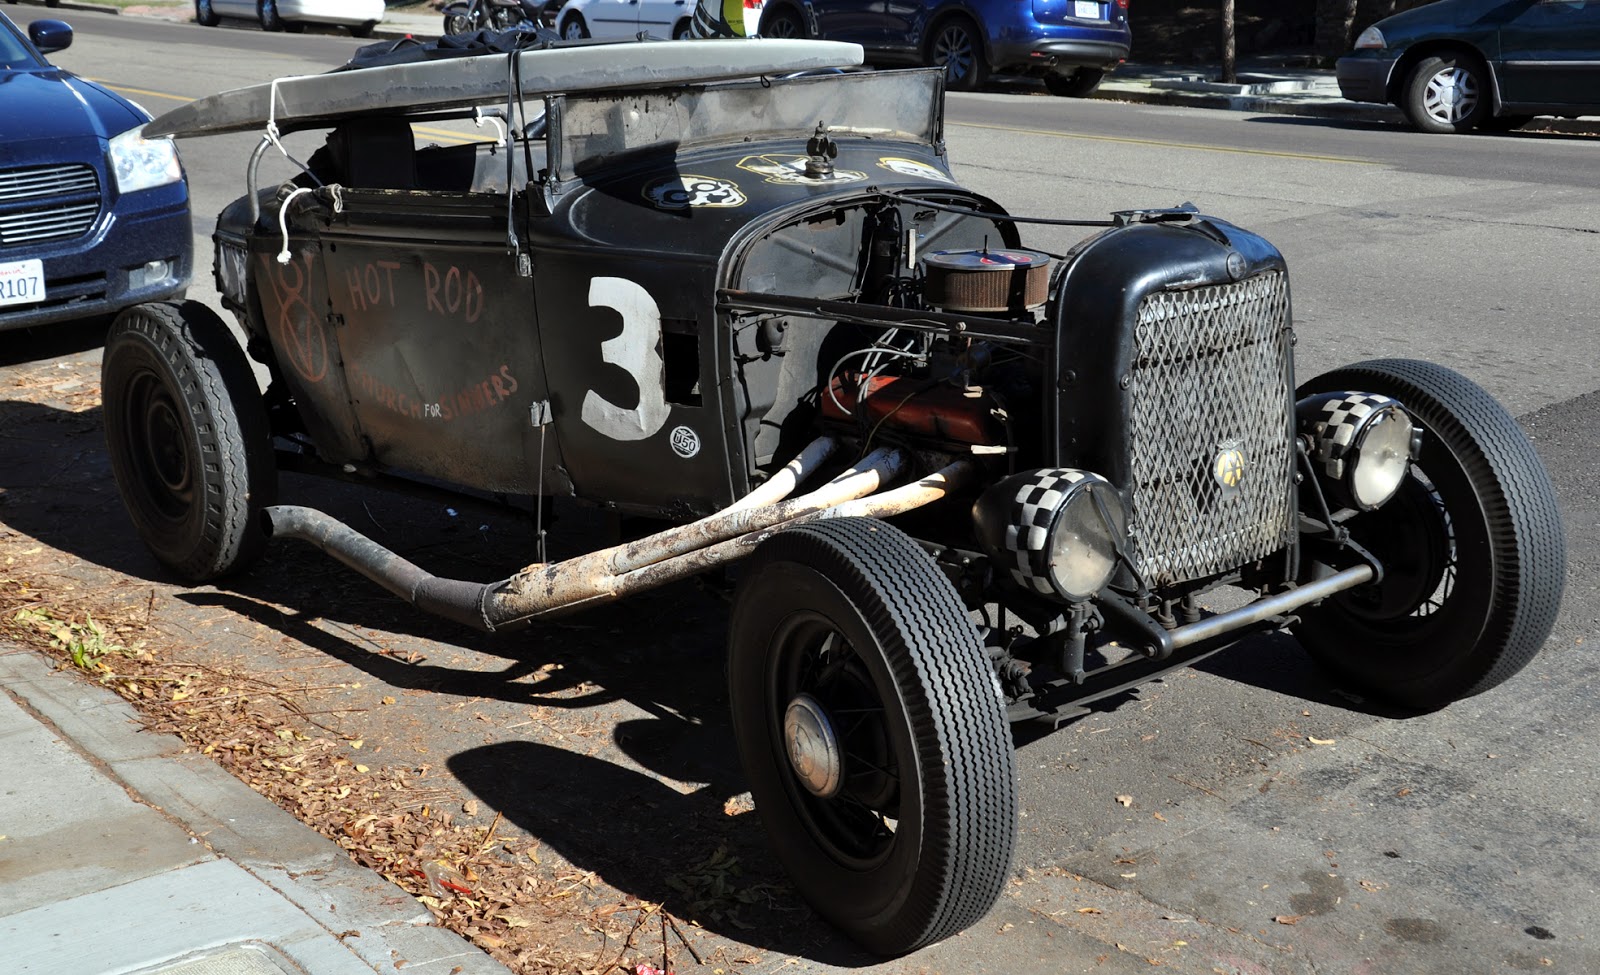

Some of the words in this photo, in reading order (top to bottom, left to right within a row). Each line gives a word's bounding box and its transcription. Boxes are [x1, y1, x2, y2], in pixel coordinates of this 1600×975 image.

[346, 260, 400, 310] HOT
[424, 262, 483, 323] ROD
[581, 276, 671, 441] 3
[424, 403, 442, 418] FOR
[440, 364, 518, 421] SINNERS
